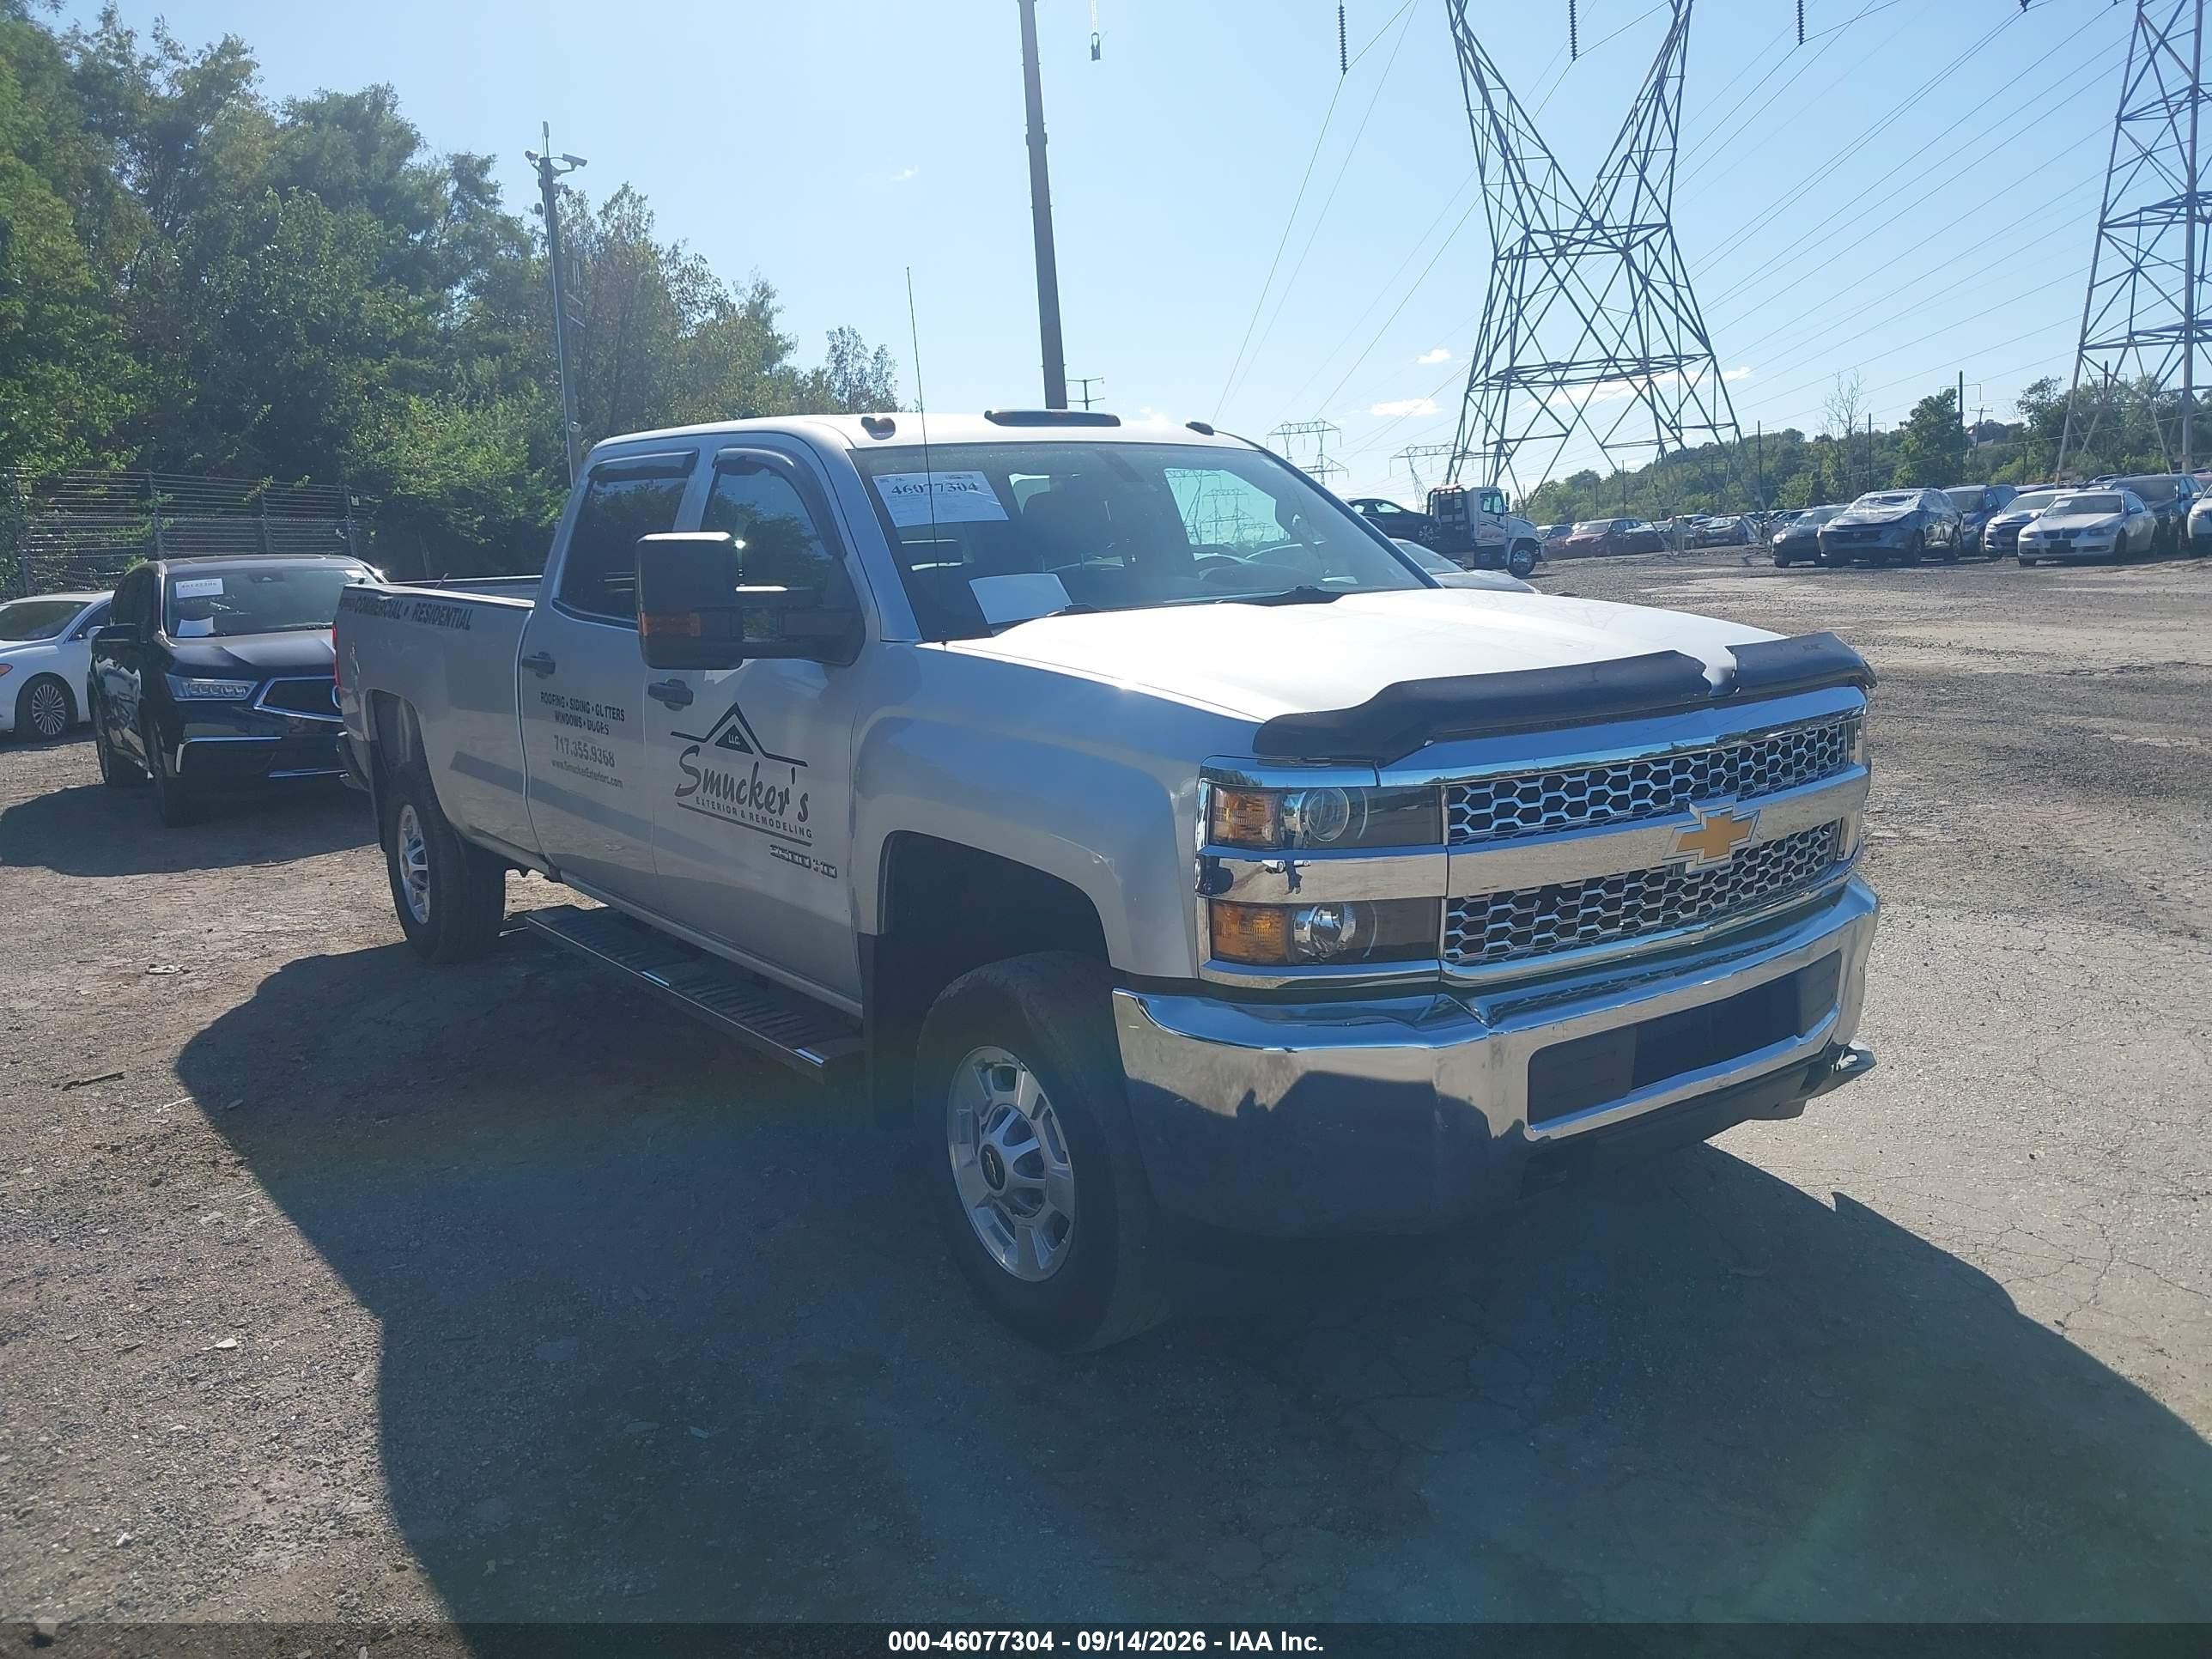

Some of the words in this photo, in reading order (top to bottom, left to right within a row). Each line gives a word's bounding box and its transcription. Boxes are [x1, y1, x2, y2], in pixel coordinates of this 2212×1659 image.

[890, 481, 979, 495] 46077304
[411, 602, 473, 631] RESIDENTIAL
[540, 690, 565, 708] ROOFING
[569, 697, 591, 714] SIDING
[554, 710, 583, 729] WINDOWS
[674, 744, 810, 823] Smucker's
[696, 795, 738, 817] EXTERIOR
[739, 809, 746, 819] &
[749, 811, 813, 839] REMODELING
